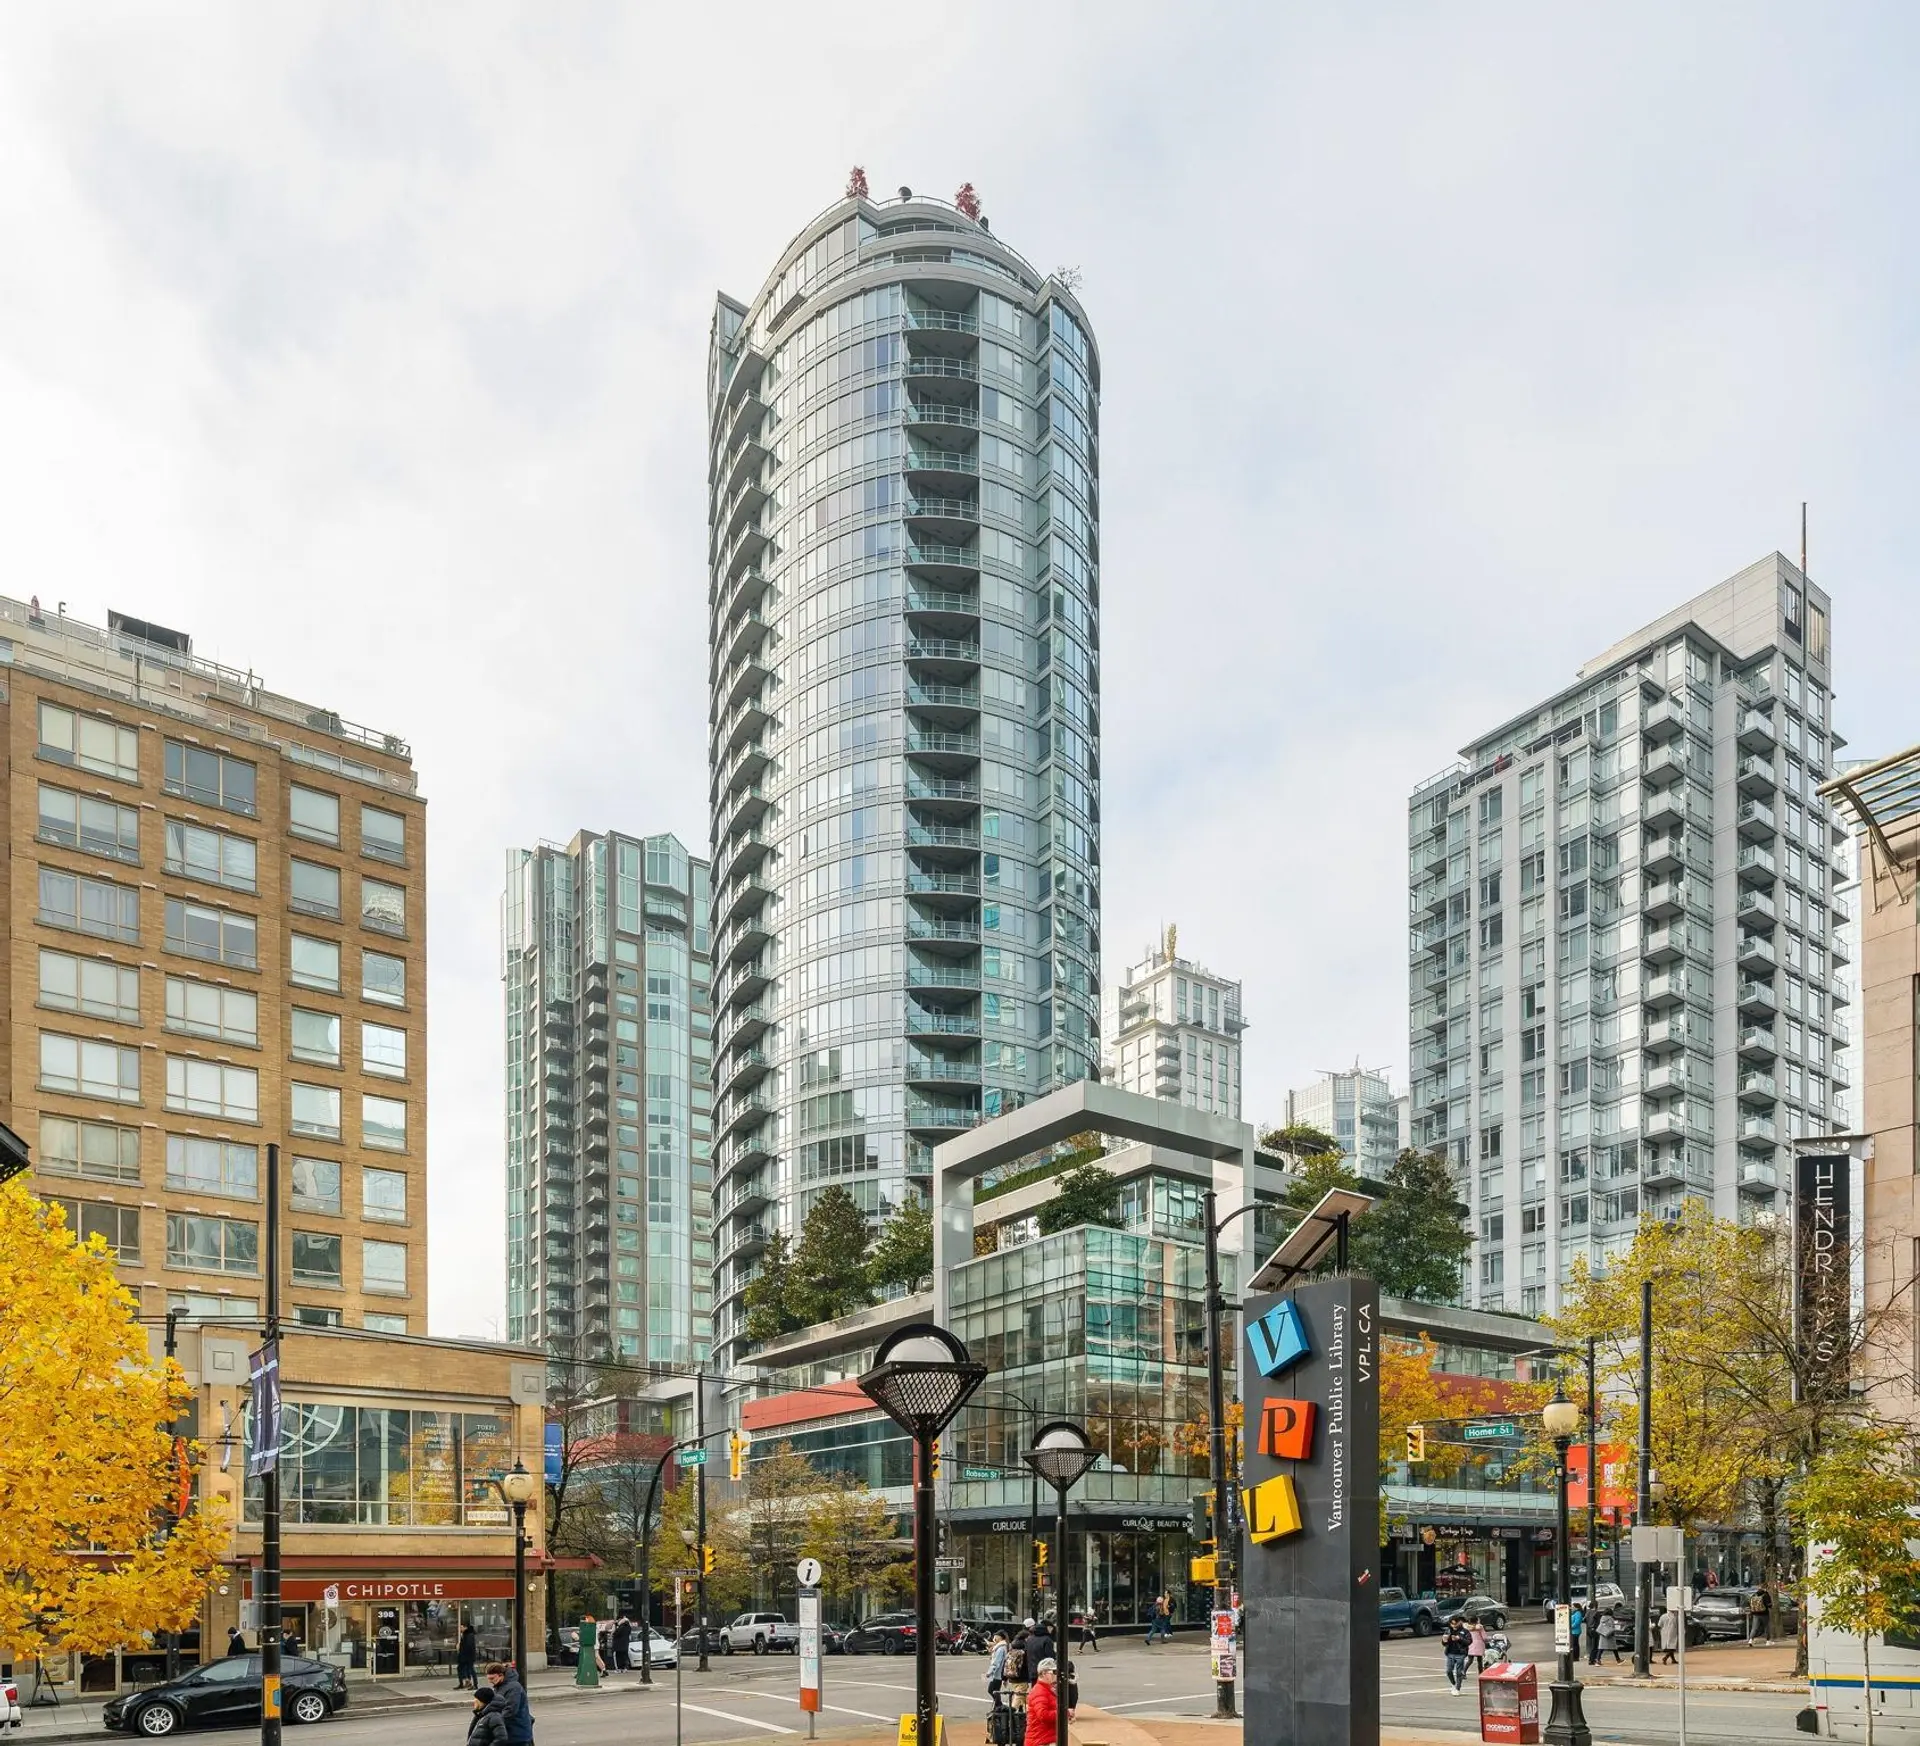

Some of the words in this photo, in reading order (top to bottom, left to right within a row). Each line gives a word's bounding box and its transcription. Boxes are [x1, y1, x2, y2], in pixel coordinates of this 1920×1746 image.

[1328, 1303, 1347, 1370] Library
[1358, 1302, 1371, 1384] VPL.CA
[1328, 1376, 1344, 1434] Public
[1468, 1428, 1496, 1437] Homer
[1499, 1425, 1510, 1435] St
[683, 1455, 698, 1463] Homer
[700, 1452, 706, 1460] St
[965, 1469, 989, 1478] Robson
[990, 1471, 998, 1479] St
[1328, 1440, 1344, 1533] Vancouver
[992, 1520, 1027, 1532] CURLIQUE
[1157, 1520, 1180, 1528] BEAUTY
[346, 1583, 444, 1596] CHIPOTLE
[377, 1610, 395, 1618] 398
[1520, 1705, 1537, 1718] MAP
